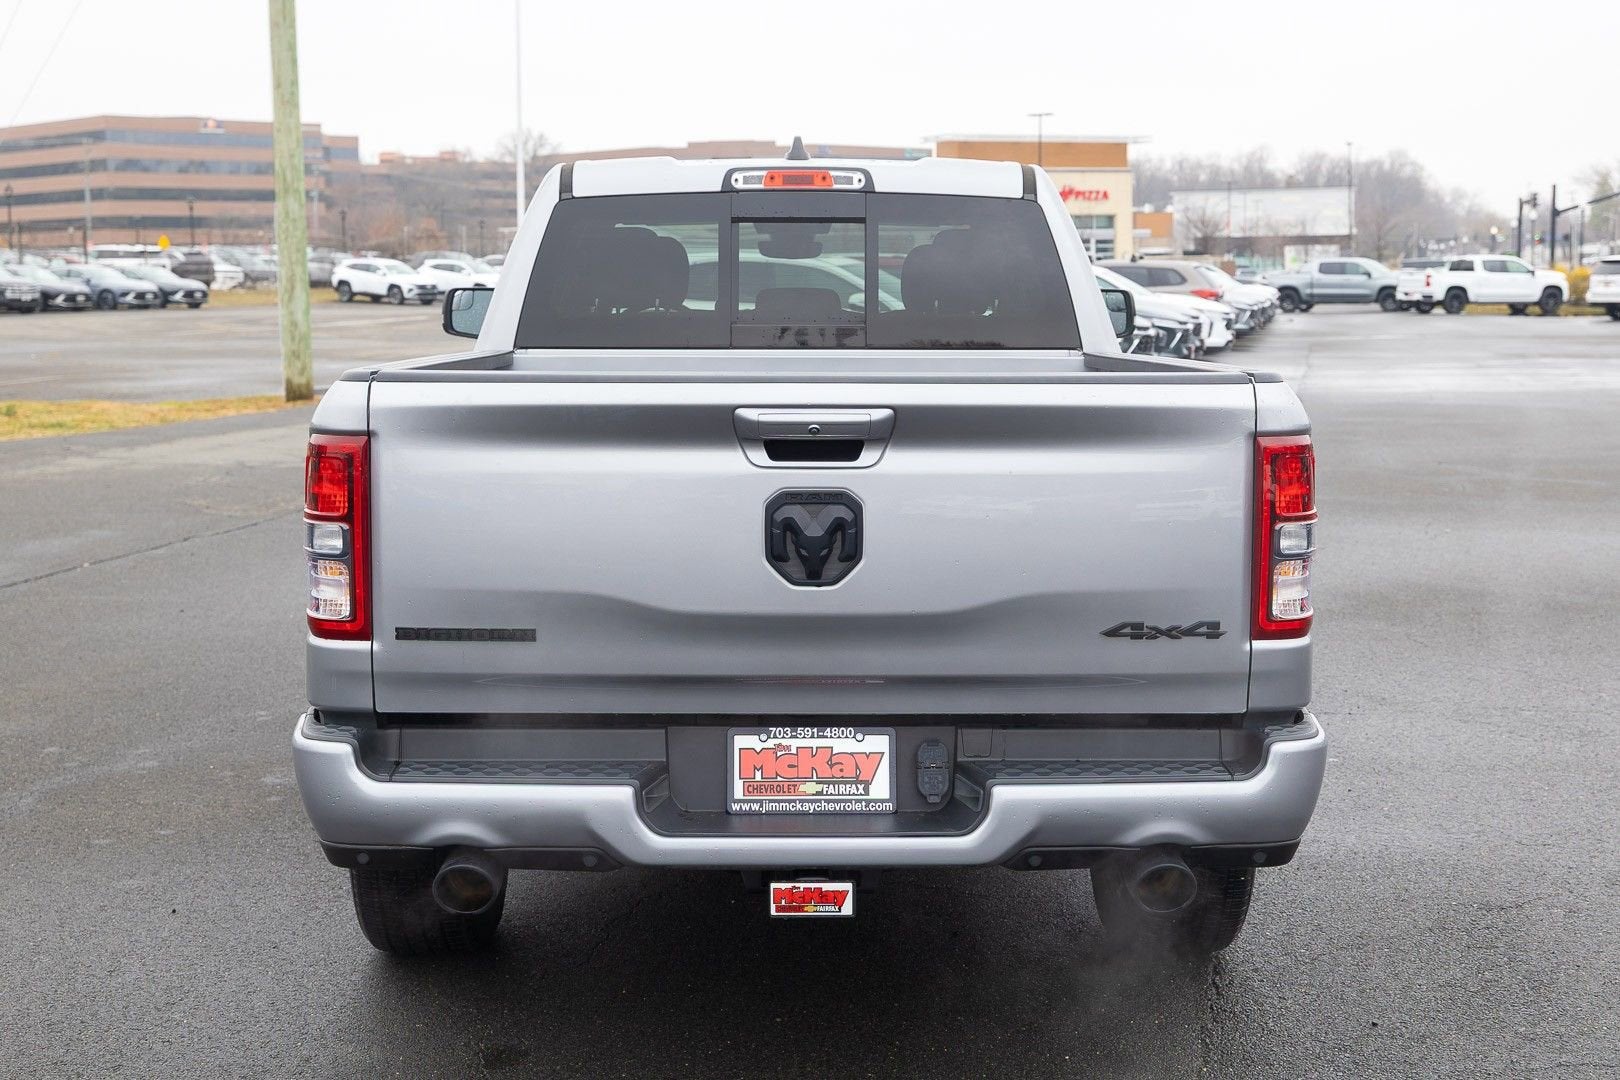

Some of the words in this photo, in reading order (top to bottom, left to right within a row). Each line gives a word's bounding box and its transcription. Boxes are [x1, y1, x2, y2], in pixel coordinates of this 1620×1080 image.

[1074, 190, 1109, 201] PIZZA
[768, 727, 855, 739] 703-591-4800
[739, 746, 885, 785] McKay
[746, 784, 798, 794] CHEVROLET
[822, 783, 865, 795] FAIRFAX
[731, 800, 893, 813] www.jimmckaychevrolet.com
[773, 887, 849, 907] McKay
